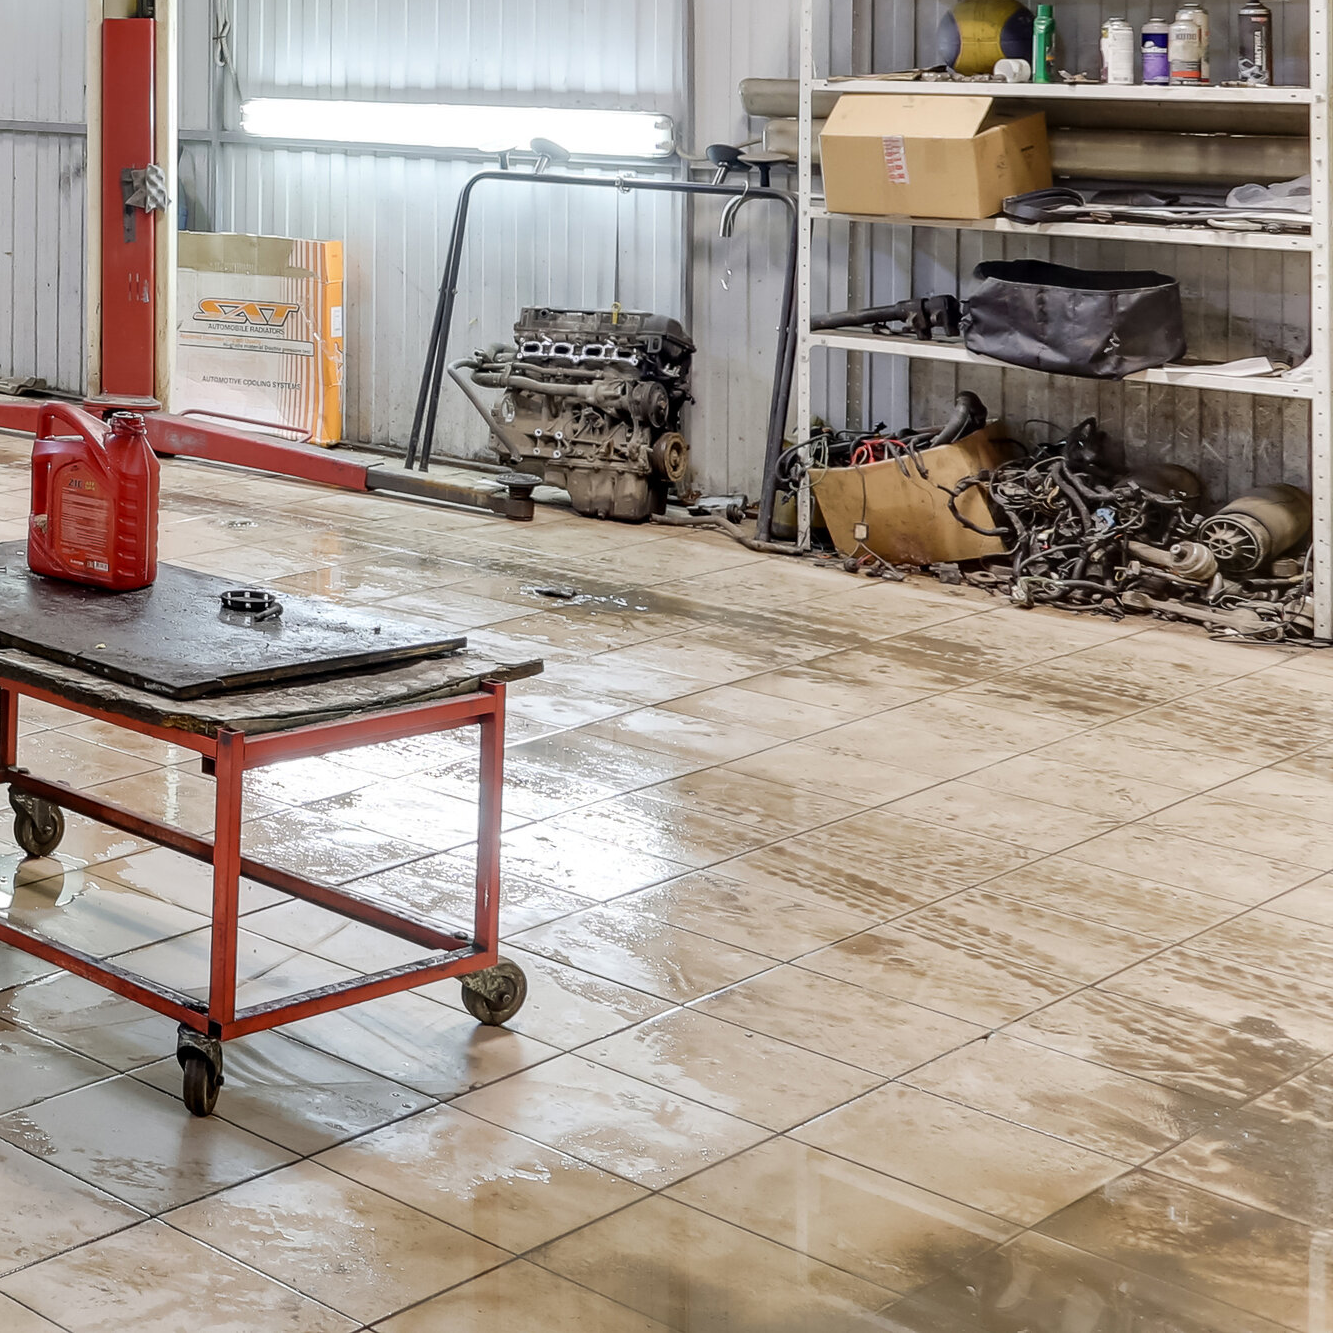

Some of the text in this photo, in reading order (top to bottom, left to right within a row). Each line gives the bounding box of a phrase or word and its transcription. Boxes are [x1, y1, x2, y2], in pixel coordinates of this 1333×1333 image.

[193, 298, 300, 327] SAT
[207, 322, 285, 335] AUTOMOBILE RADIATORS
[202, 375, 301, 390] AUTOMOTIVE COOLING SYSTEMS
